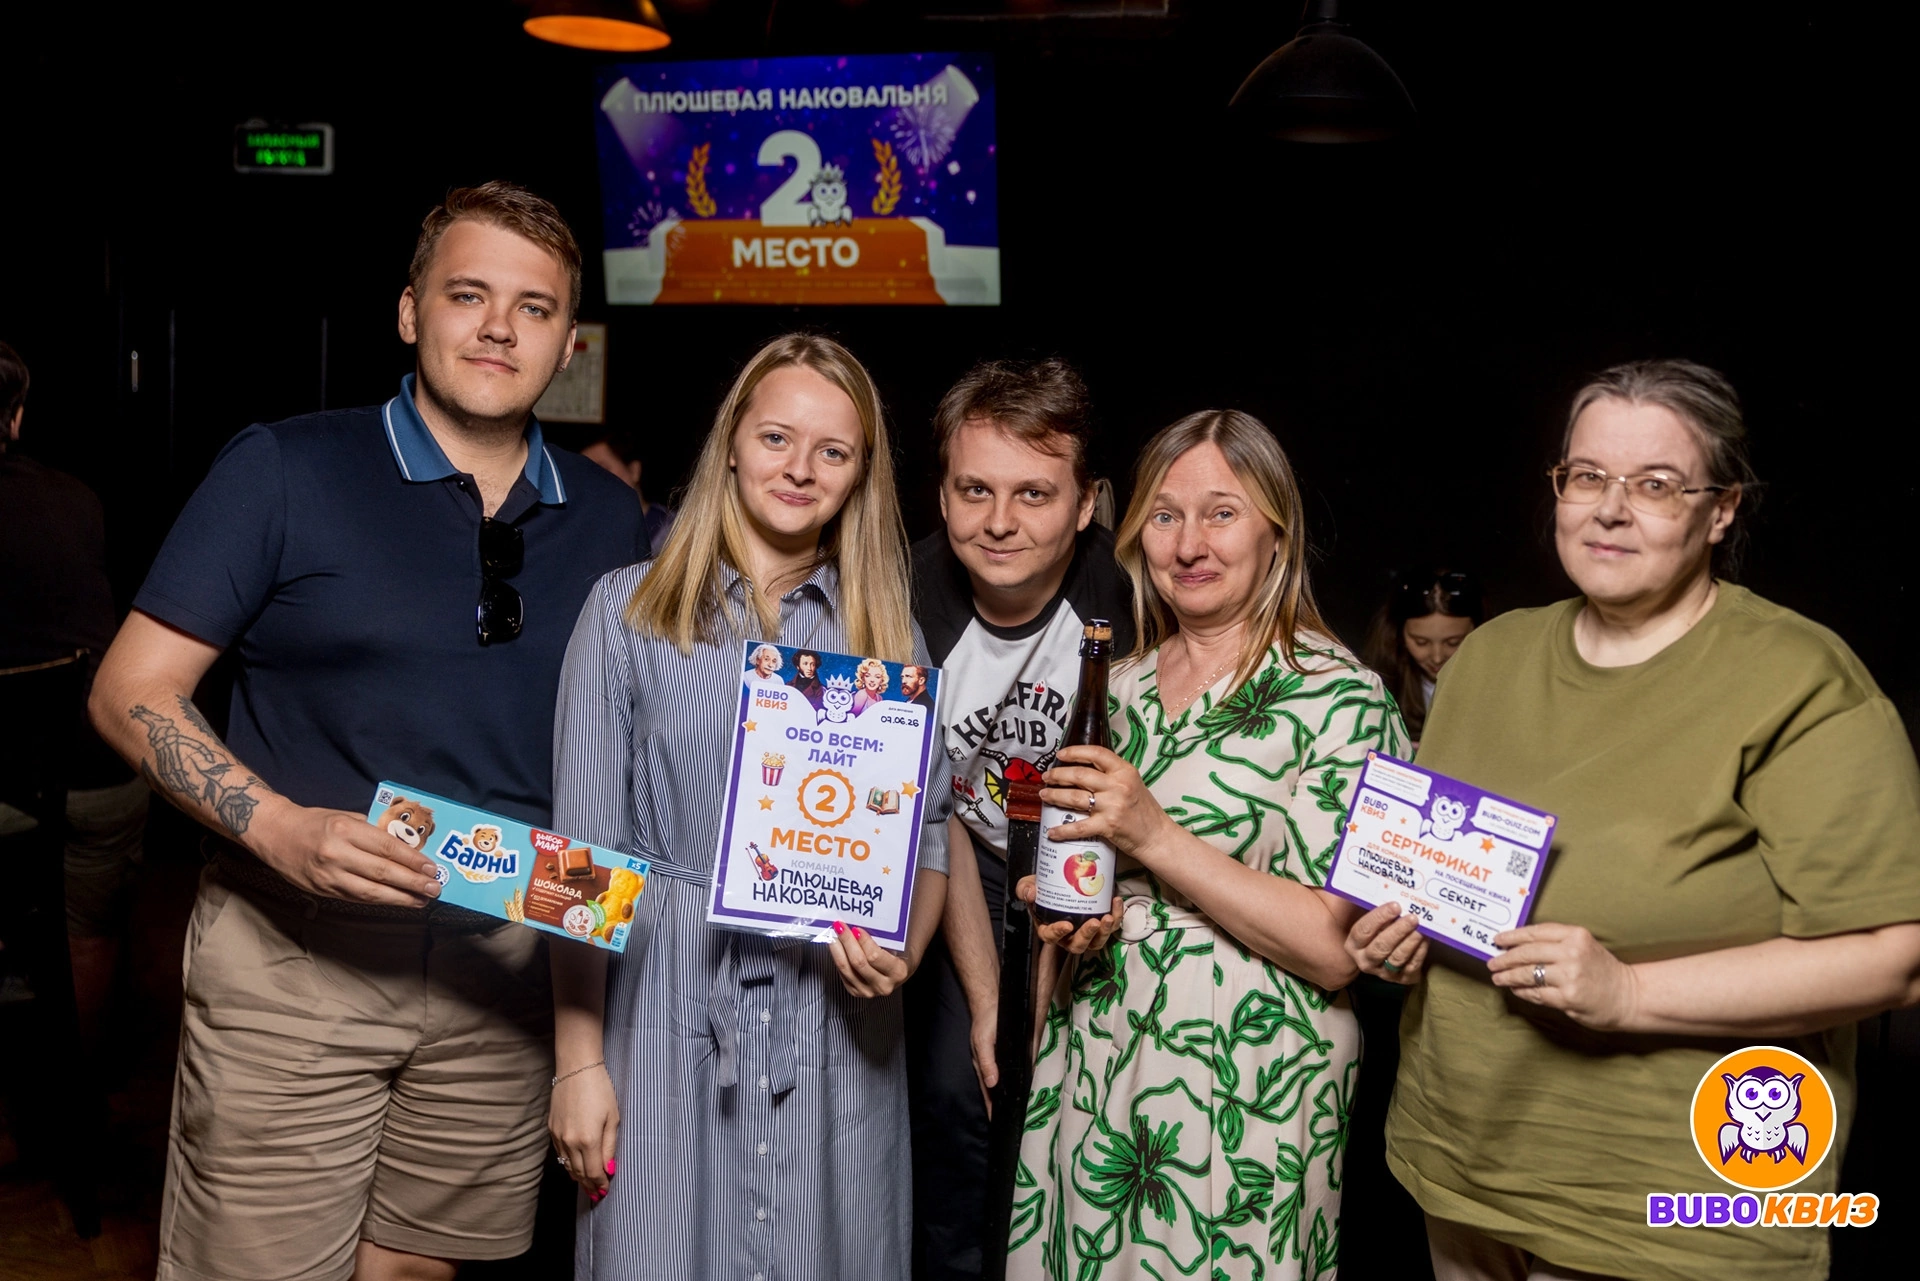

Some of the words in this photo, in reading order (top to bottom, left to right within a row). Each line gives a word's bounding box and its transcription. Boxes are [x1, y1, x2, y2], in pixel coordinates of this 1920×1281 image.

[634, 88, 772, 113] ПЛЮШЕВАЯ
[780, 84, 948, 109] НАКОВАЛЬНЯ
[757, 129, 822, 227] 2
[732, 237, 860, 268] МЕСТО
[755, 697, 788, 711] КВИЗ
[756, 688, 789, 701] BUBO
[785, 727, 823, 744] ОБО
[828, 733, 884, 753] ВСЕМ:
[987, 717, 1047, 748] CLUB
[807, 748, 857, 768] ЛАЙТ
[815, 785, 837, 812] 2
[1363, 796, 1388, 811] BUBO
[1360, 805, 1386, 820] КВИЗ
[1482, 810, 1541, 836] BUBO-QUIZ.COM
[536, 833, 563, 845] ВЫБОР
[770, 827, 871, 862] МЕСТО
[440, 834, 516, 874] Барни
[791, 859, 845, 875] КОМАНДА
[1381, 830, 1492, 882] СЕРТИФИКАТ
[780, 868, 883, 902] ПЛЮШЕВАЯ
[1435, 869, 1444, 877] НА
[1445, 873, 1487, 894] ПОСЕЩЕНИЕ
[753, 882, 874, 917] НАКОВАЛЬНЯ
[1408, 903, 1433, 922] 50%
[1439, 887, 1487, 912] СЕКРЕТ
